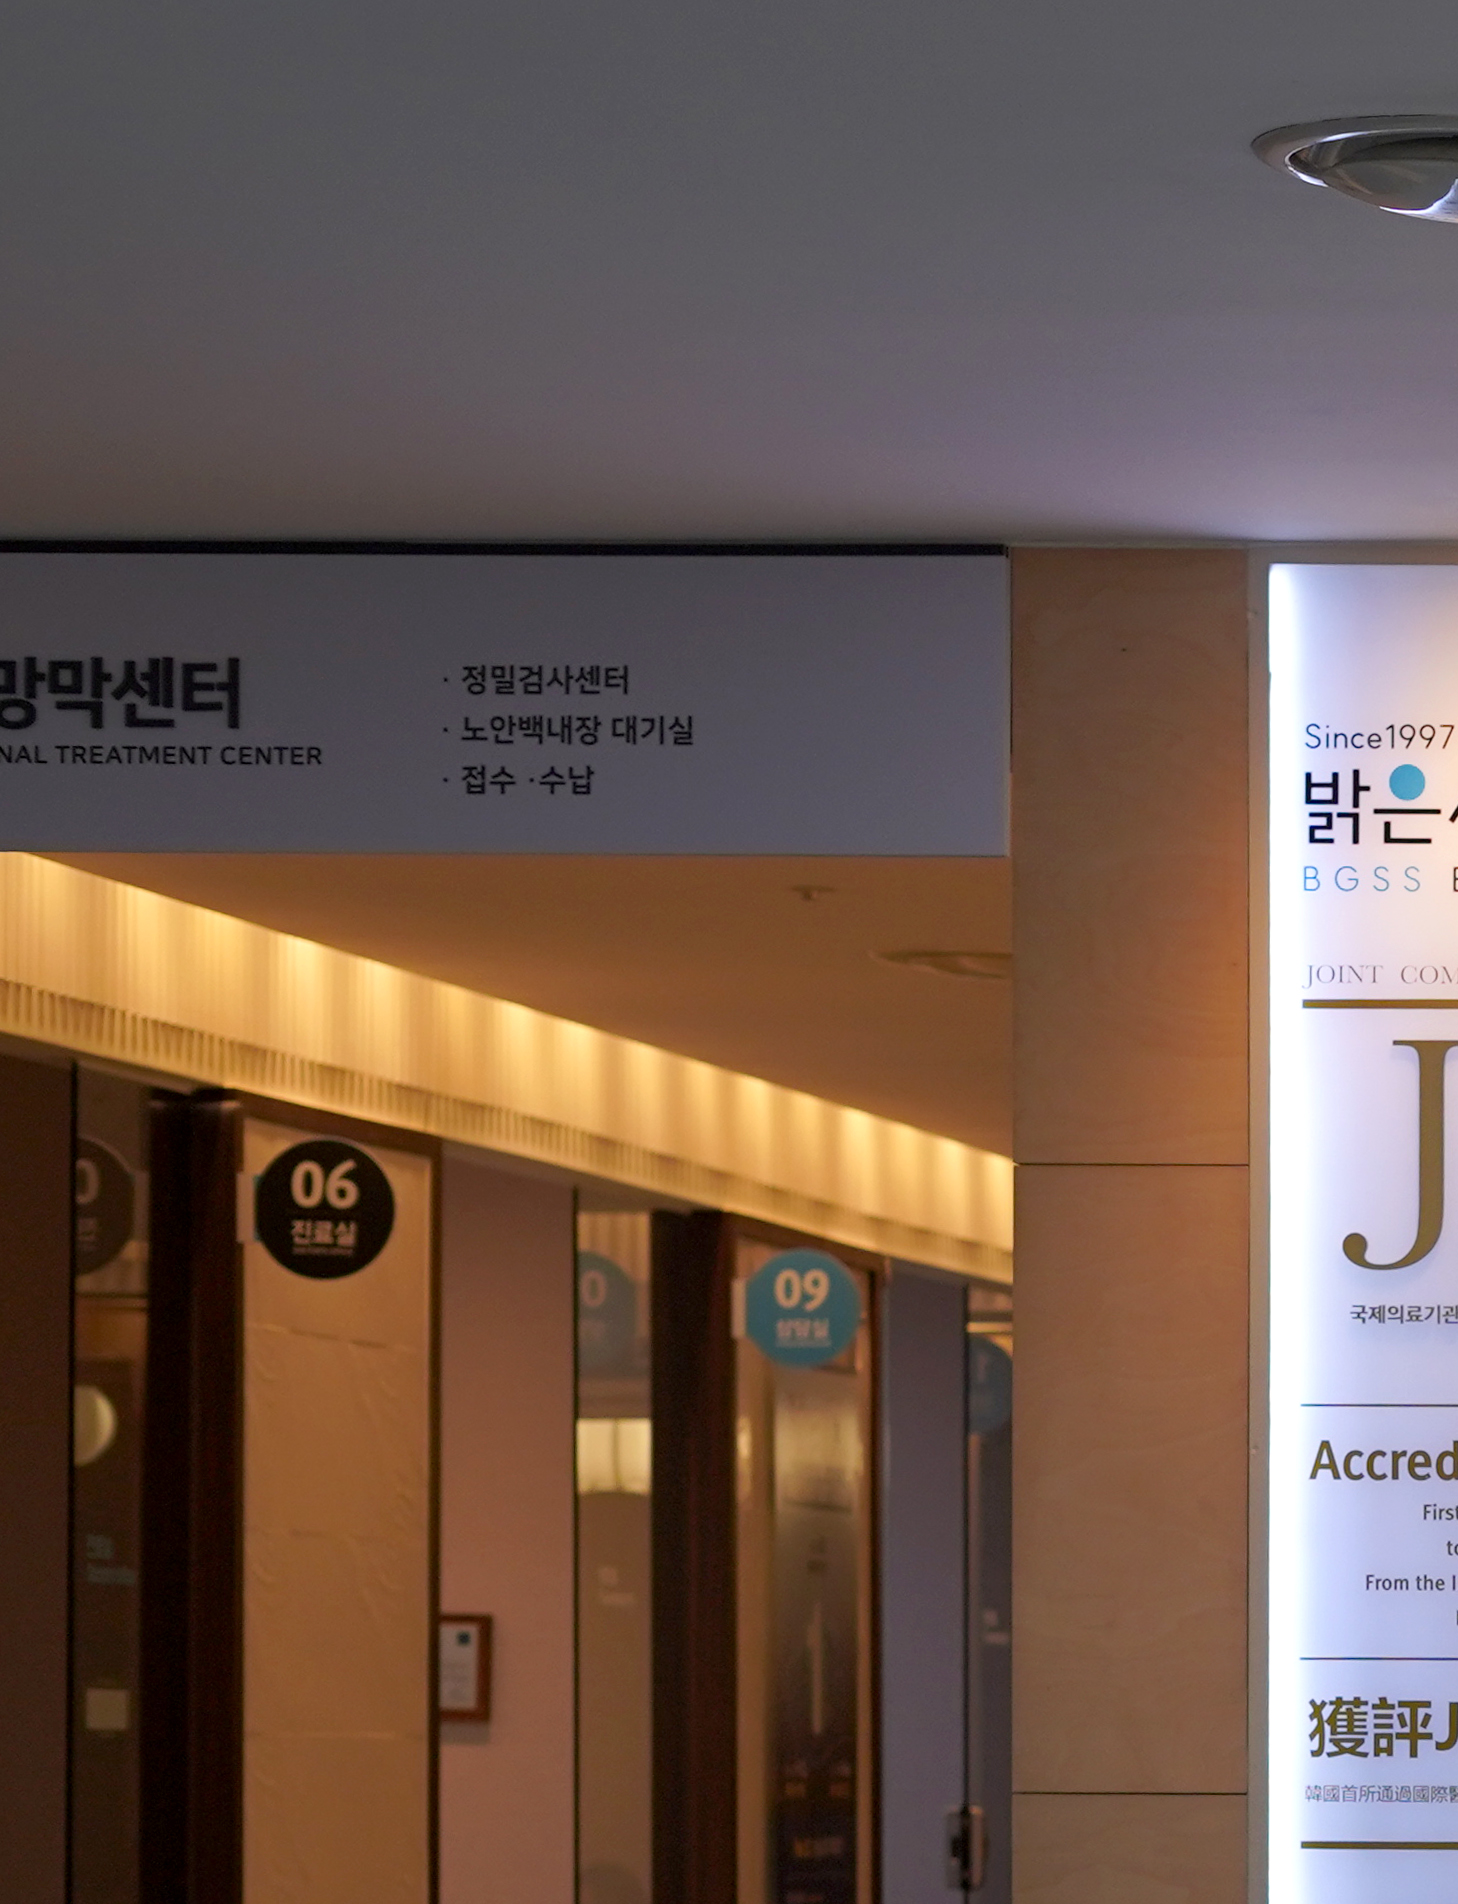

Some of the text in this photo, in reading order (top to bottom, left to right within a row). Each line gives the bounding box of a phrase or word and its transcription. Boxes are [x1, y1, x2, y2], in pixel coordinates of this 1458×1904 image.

[0, 655, 241, 731] 망막센터
[461, 664, 629, 696] 정밀검사센터
[460, 714, 694, 746] 노안백내장 대기실
[1305, 723, 1455, 750] Since1997
[54, 745, 213, 765] TREATMENT
[220, 745, 323, 766] CENTER
[1303, 865, 1420, 892] BGSS
[1303, 964, 1383, 989] JOINT
[290, 1158, 361, 1210] 06
[773, 1267, 831, 1313] 09
[1365, 1574, 1410, 1591] From
[1415, 1574, 1446, 1592] the
